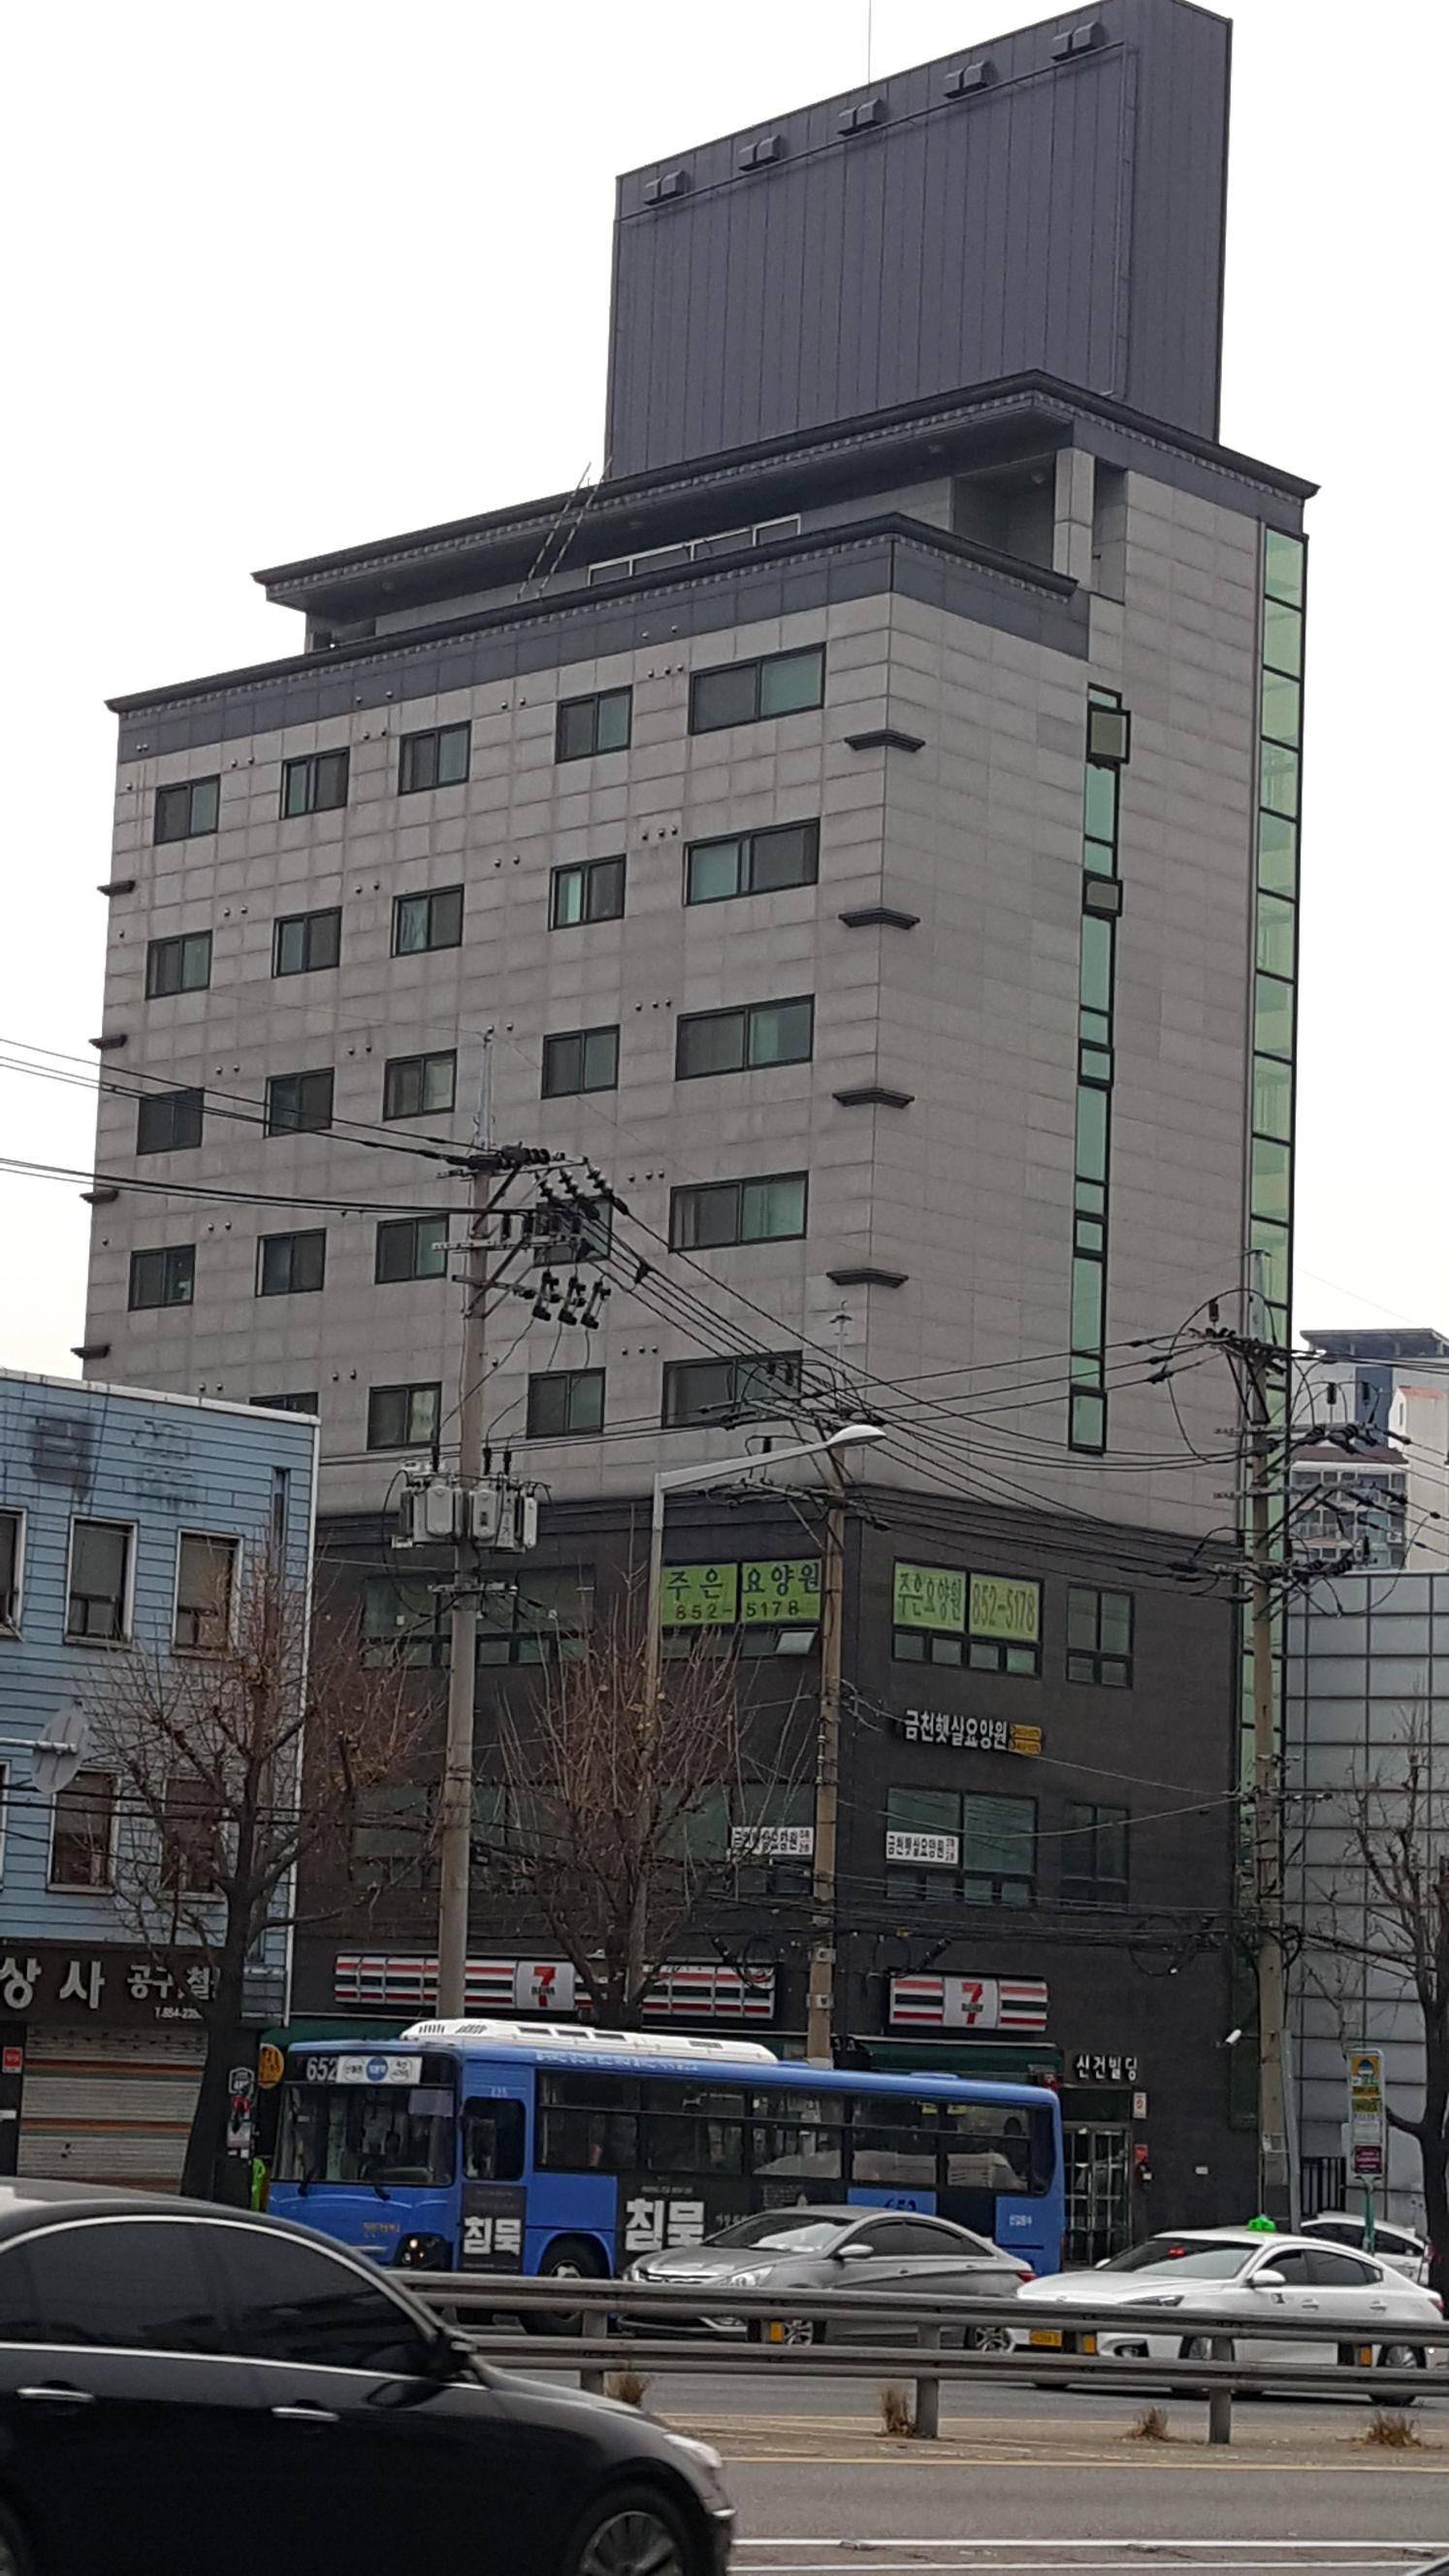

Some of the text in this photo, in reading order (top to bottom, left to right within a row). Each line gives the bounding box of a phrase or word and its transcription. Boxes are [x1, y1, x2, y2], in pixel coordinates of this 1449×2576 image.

[666, 1562, 820, 1601] 주은 요양원
[898, 1571, 962, 1621] 주은요양원
[972, 1582, 1035, 1632] 852-5178
[306, 2056, 338, 2082] 652
[1076, 2054, 1138, 2081] 신건빌딩
[463, 2215, 522, 2257] 침묵
[626, 2198, 704, 2251] 침묵
